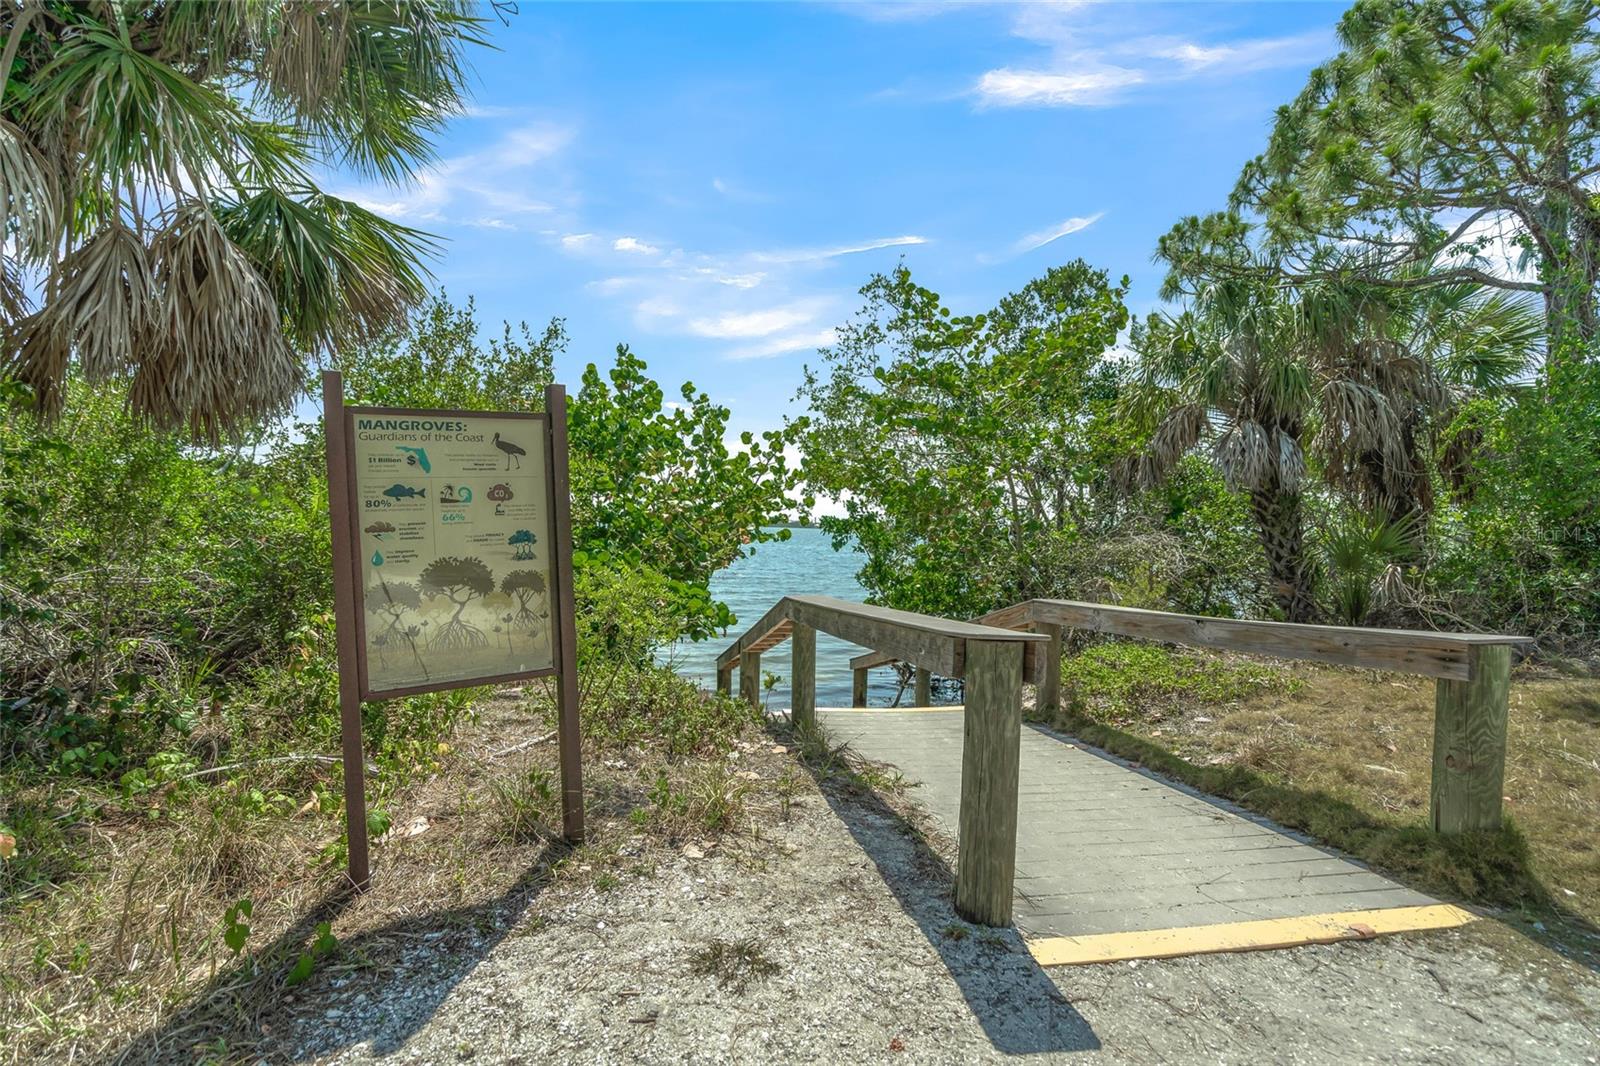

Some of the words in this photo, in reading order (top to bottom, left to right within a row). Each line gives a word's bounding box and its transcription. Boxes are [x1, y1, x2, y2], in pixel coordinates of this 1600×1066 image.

[358, 420, 468, 432] MANGROVES:
[358, 431, 417, 442] Guardians
[420, 432, 431, 442] of
[434, 432, 453, 442] the
[455, 433, 484, 443] Coast
[365, 500, 392, 508] 80%
[442, 513, 466, 521] 66%
